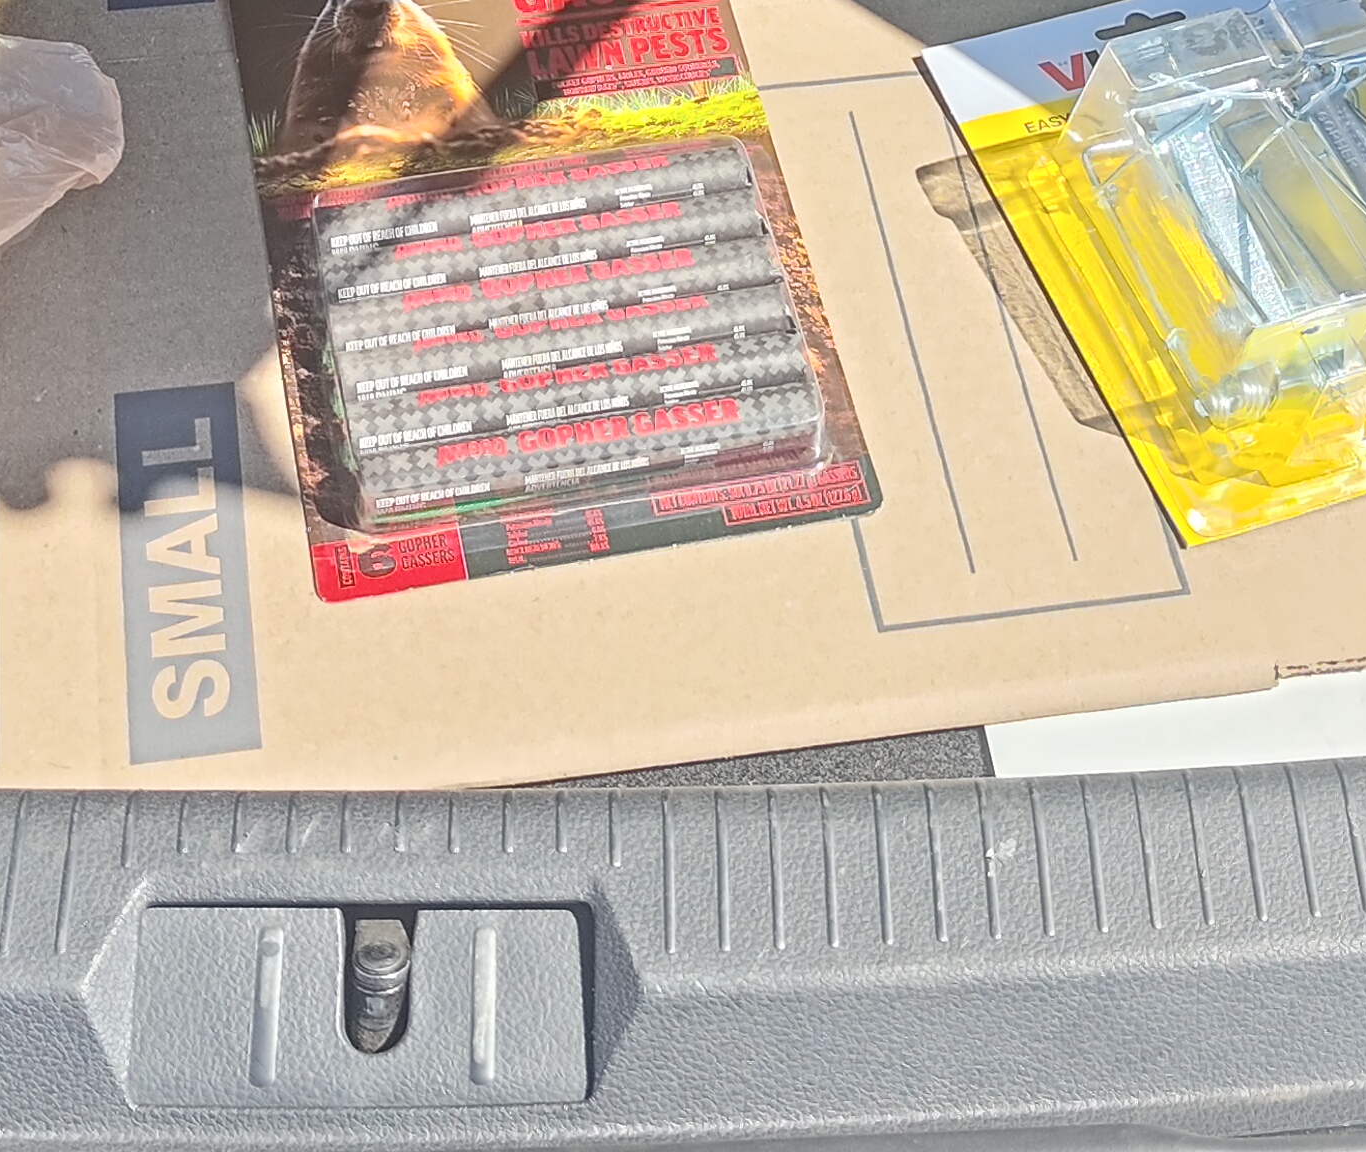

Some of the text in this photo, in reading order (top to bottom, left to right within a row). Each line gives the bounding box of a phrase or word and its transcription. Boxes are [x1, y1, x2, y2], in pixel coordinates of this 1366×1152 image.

[519, 6, 723, 49] KILLS DESTRUCTIVE
[528, 24, 731, 81] LAWN PESTS
[329, 234, 349, 248] KEEP
[347, 232, 363, 245] OUT
[361, 231, 372, 243] OF
[371, 227, 395, 242] REACH
[394, 226, 404, 238] OF
[403, 220, 439, 236] CHILDREN
[469, 217, 578, 249] GOPHER
[578, 200, 682, 232] GASSER
[337, 271, 447, 300] KEEP OUT OF REACH OF CHILDREN
[479, 246, 695, 300] GOPHER GASSER
[344, 323, 456, 352] KEEP OUT OF REACH OF CHILDREN
[355, 379, 375, 395] KEEP
[374, 377, 390, 391] OUT
[389, 375, 400, 389] OF
[399, 371, 423, 387] REACH
[422, 370, 433, 383] OF
[432, 364, 468, 382] CHILDREN
[358, 419, 473, 451] KEEP OUT OF REACH OF CHILDREN
[516, 413, 631, 457] GOPHER
[630, 394, 742, 438] GASSER
[375, 496, 395, 511] KEEP
[394, 494, 410, 508] OUT
[409, 492, 421, 505] OF
[420, 487, 445, 503] REACH
[444, 486, 455, 499] OF
[454, 479, 491, 497] CHILDREN
[398, 533, 448, 554] GOPHER
[400, 548, 455, 570] GASSERS
[141, 416, 232, 721] SMALL
[357, 542, 398, 579] 6
